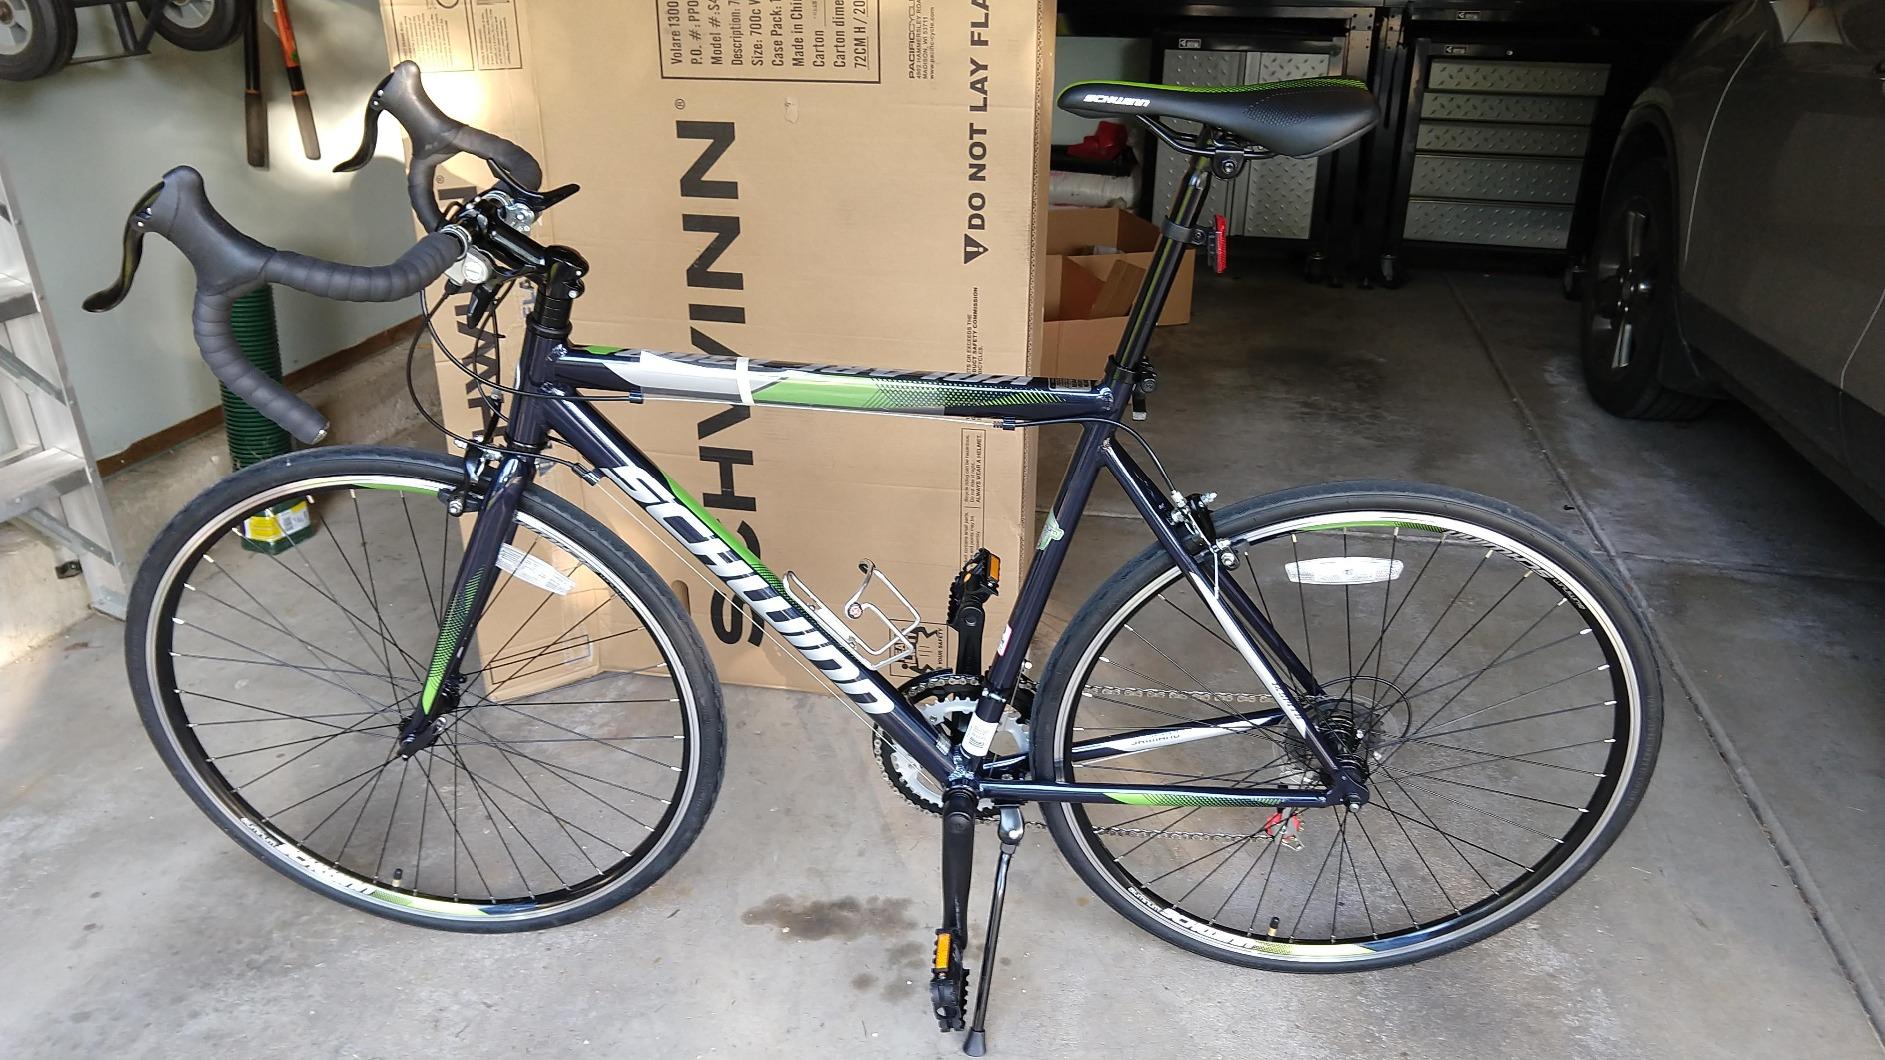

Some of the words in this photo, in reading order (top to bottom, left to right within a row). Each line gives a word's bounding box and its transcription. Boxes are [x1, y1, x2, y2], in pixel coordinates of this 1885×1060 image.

[667, 0, 681, 28] 1300
[750, 8, 763, 36] 700c
[770, 6, 784, 37] Pack:
[792, 24, 804, 34] in
[669, 30, 683, 65] Volare
[710, 32, 723, 65] Model
[730, 8, 744, 65] Description:
[752, 39, 764, 66] Size:
[792, 37, 805, 67] Made
[812, 30, 825, 67] Carton
[833, 30, 846, 68] Carton
[771, 40, 784, 67] Case
[854, 37, 867, 69] 72CM
[969, 57, 988, 112] LAY
[1083, 94, 1150, 108] SCHWINN
[968, 123, 987, 181] NOT
[968, 192, 986, 230] DO
[601, 466, 895, 714] SCHWINN
